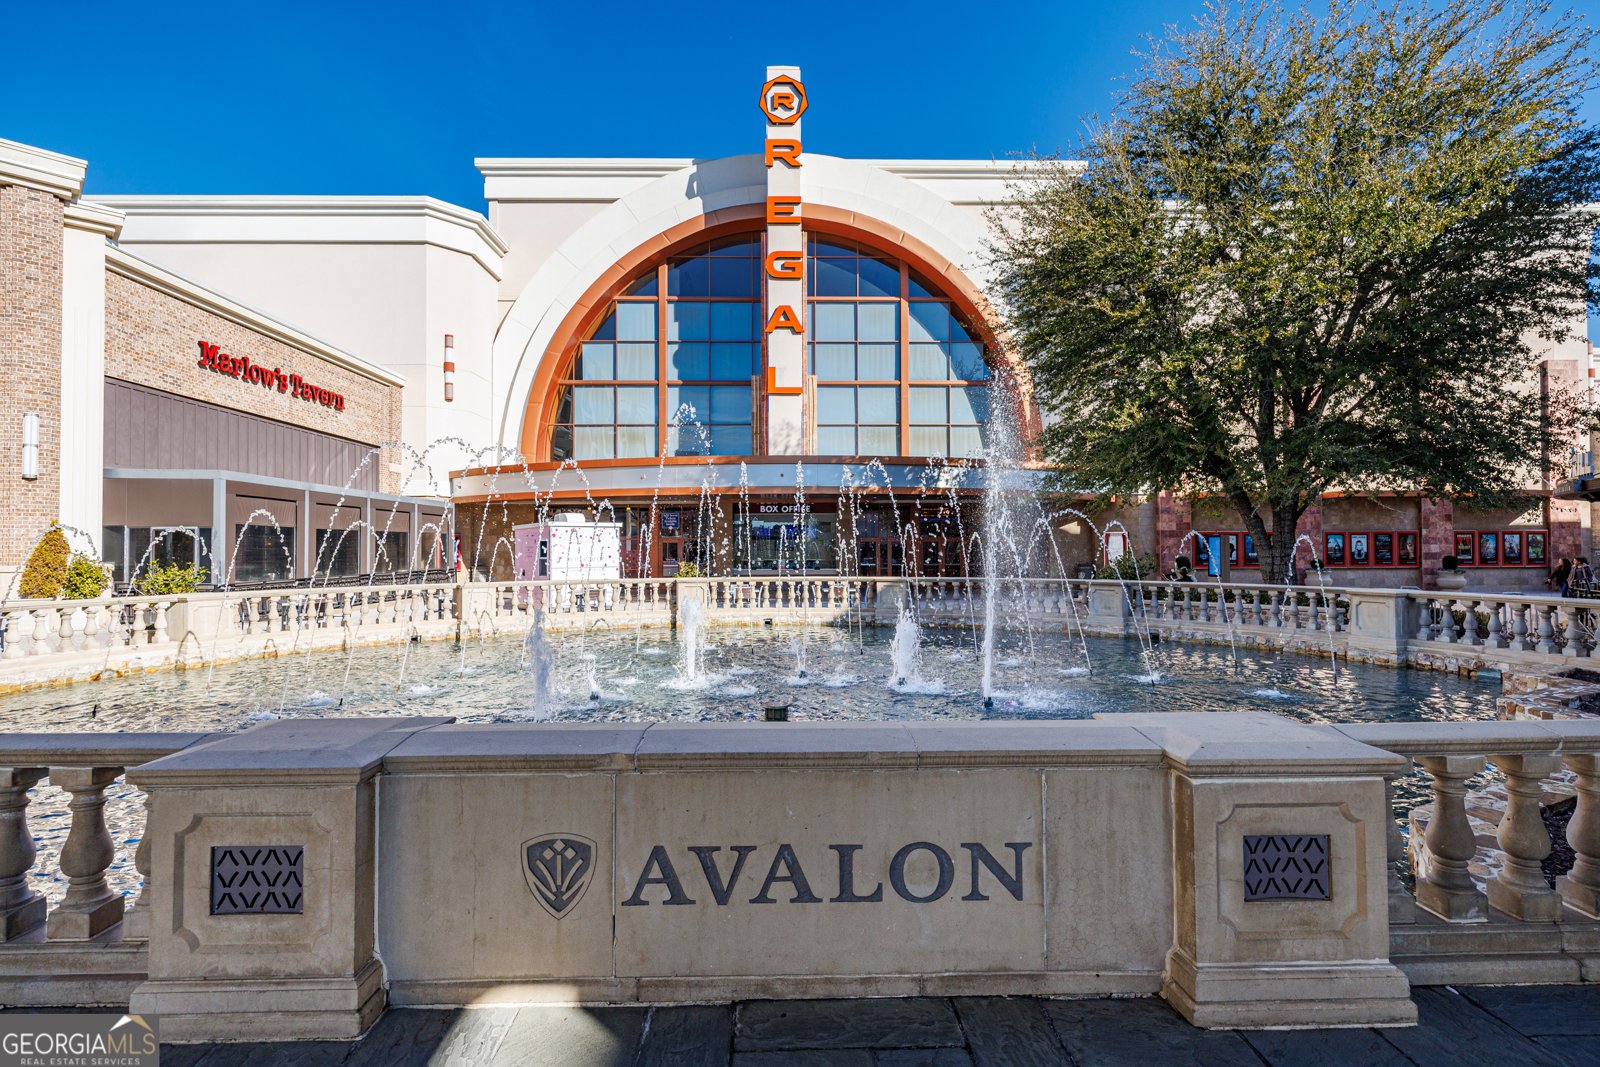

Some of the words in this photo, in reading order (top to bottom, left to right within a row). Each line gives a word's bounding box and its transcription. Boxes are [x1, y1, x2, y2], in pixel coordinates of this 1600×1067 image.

[774, 92, 795, 109] R
[765, 138, 803, 395] REGAL
[199, 341, 289, 391] Marlow's
[291, 374, 345, 410] Tavern
[760, 505, 779, 513] BOX
[621, 841, 1033, 906] AVALON
